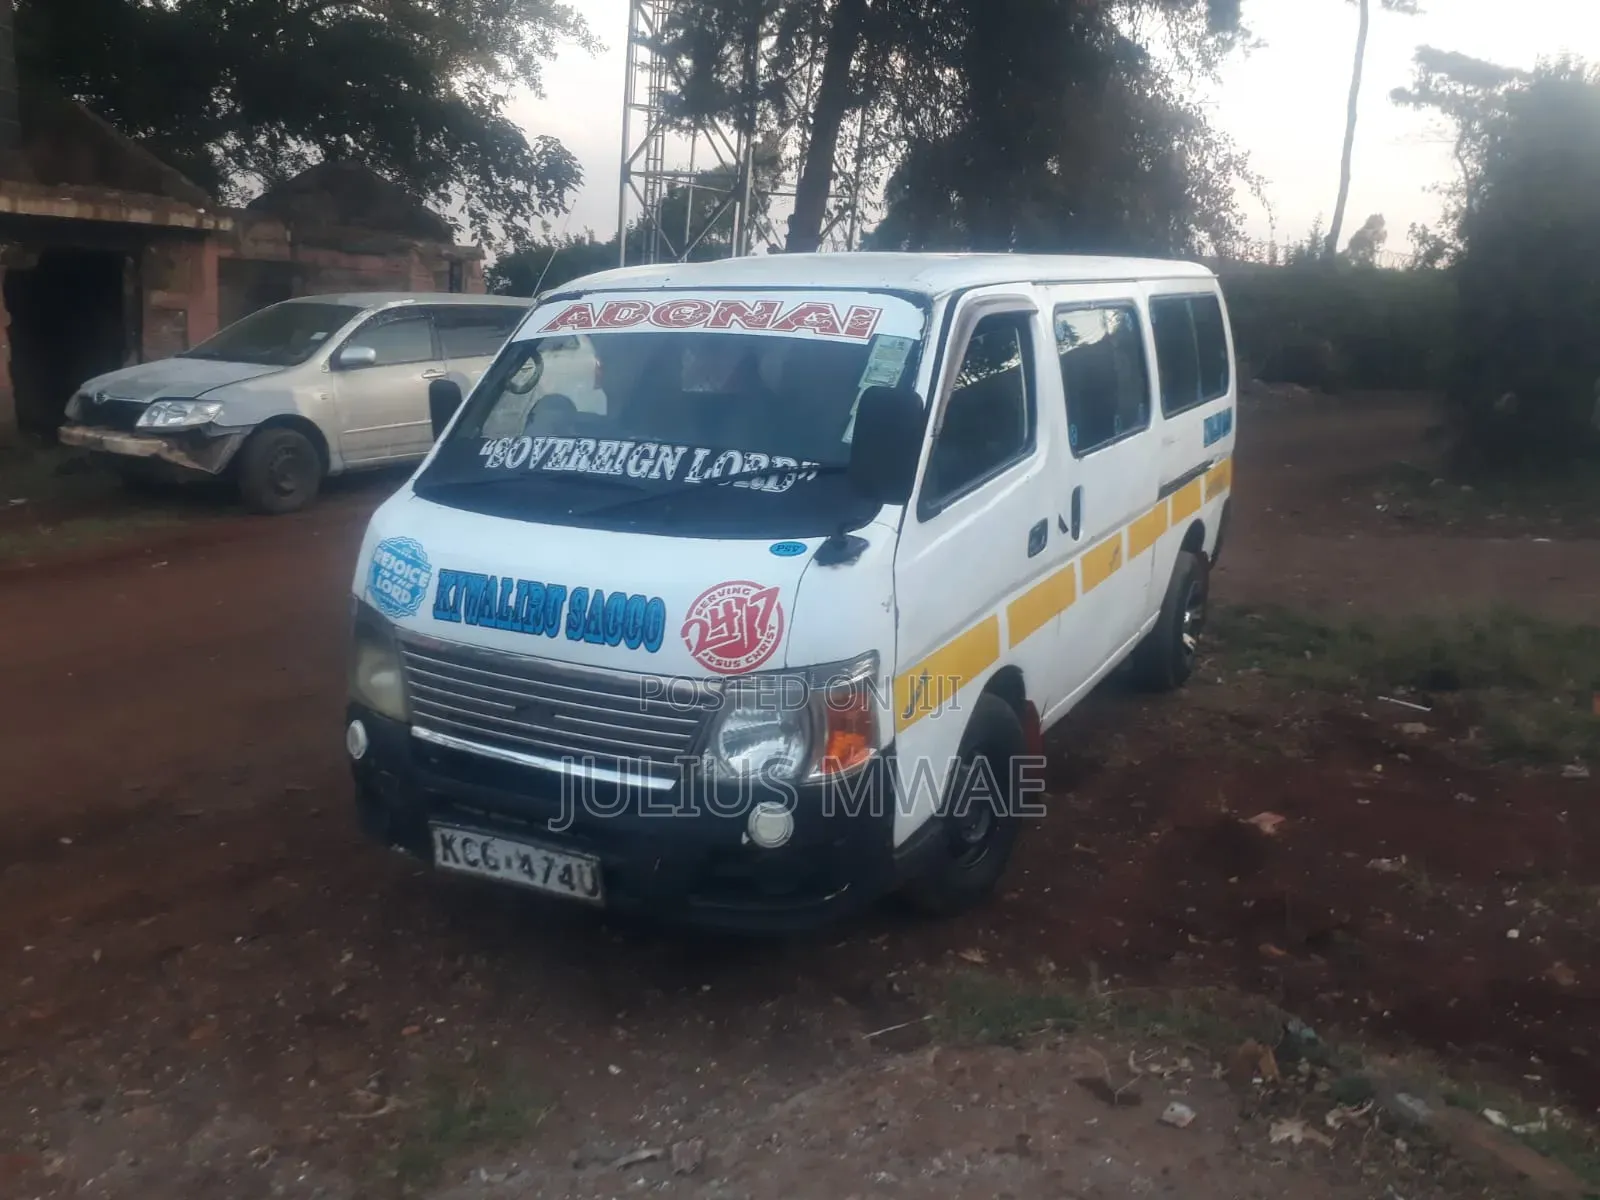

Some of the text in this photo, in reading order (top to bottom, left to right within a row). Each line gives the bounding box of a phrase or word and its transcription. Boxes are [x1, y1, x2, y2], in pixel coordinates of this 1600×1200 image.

[536, 299, 883, 340] ADONAI
[376, 574, 412, 604] LORD
[695, 587, 752, 616] SERVING
[565, 586, 666, 653] SACCO
[702, 623, 776, 668] JESUS CHRIST
